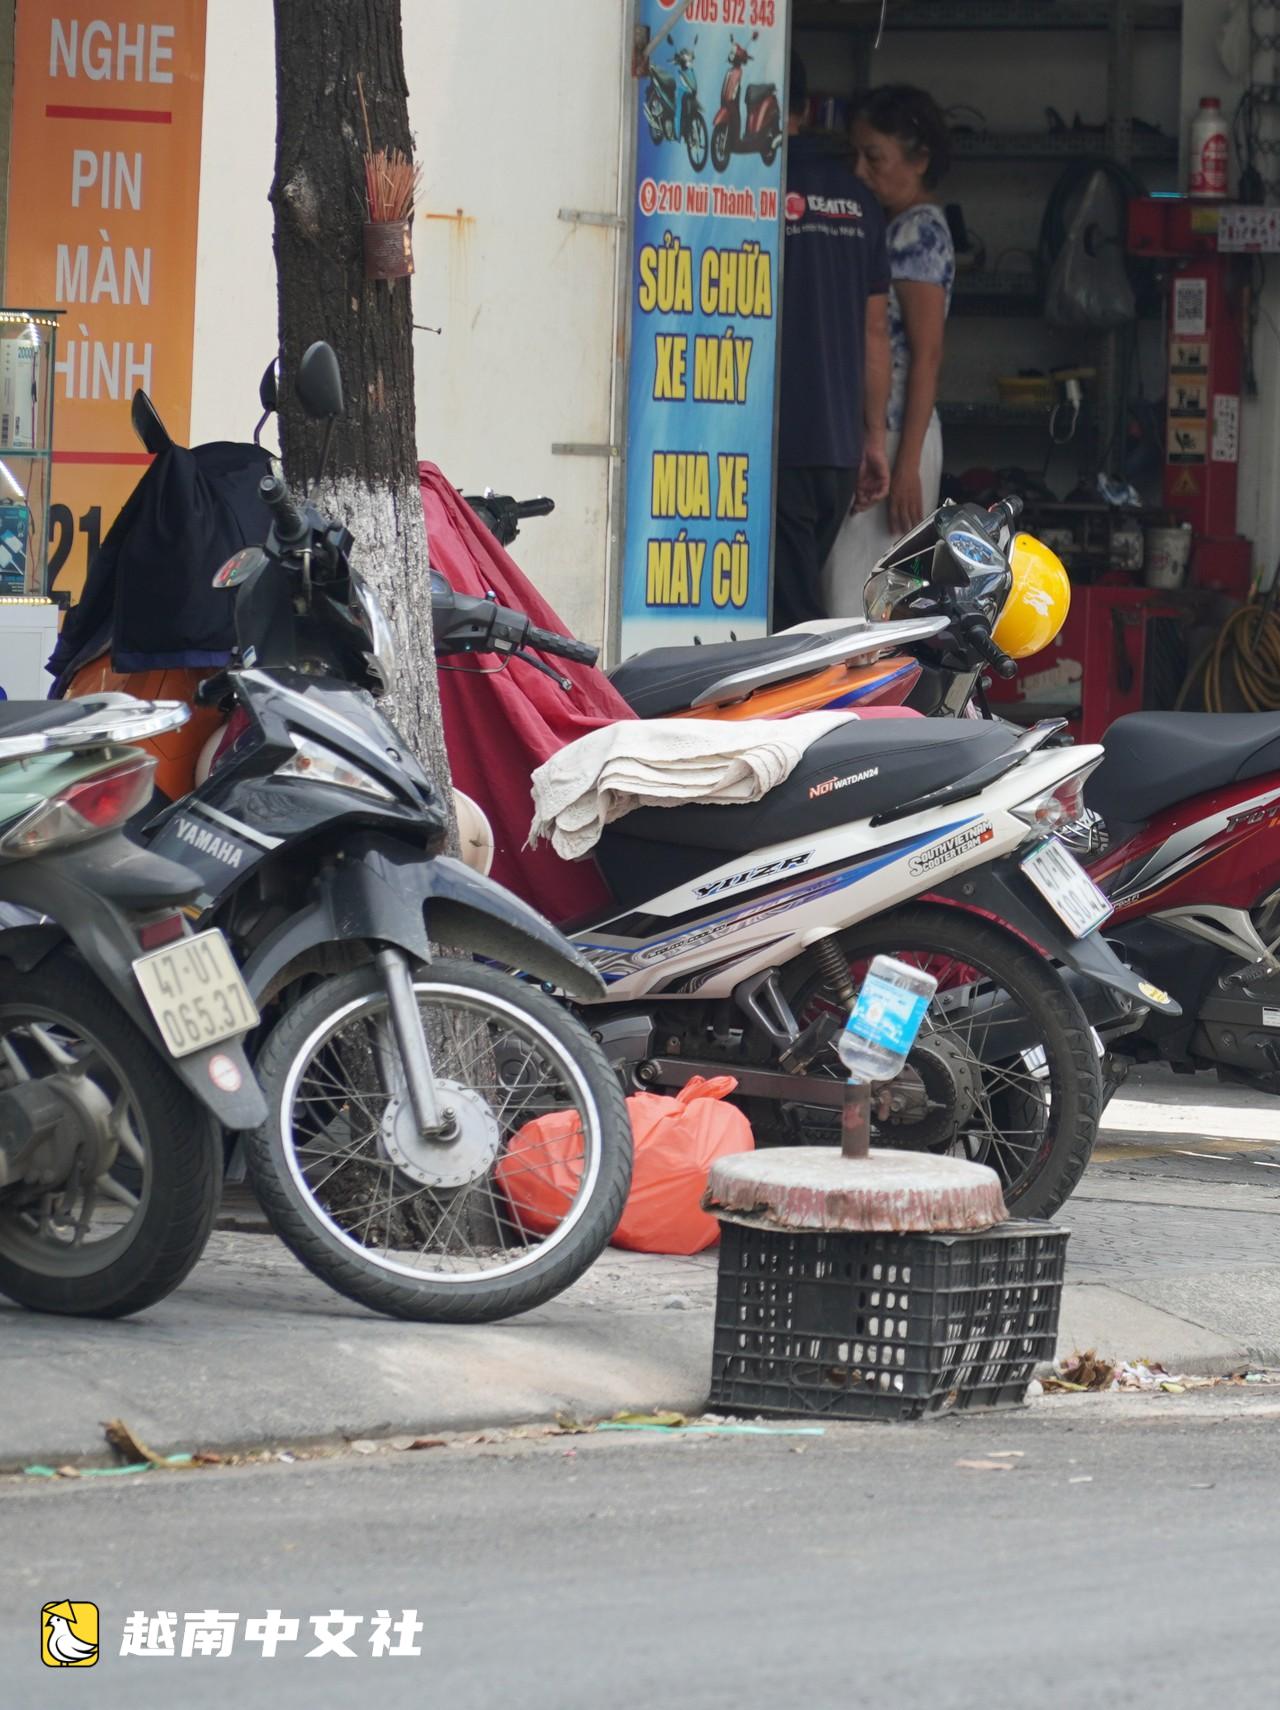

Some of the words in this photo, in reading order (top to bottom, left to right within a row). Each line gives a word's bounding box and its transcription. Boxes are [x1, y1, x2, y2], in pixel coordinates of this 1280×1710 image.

[723, 0, 746, 25] 972
[750, 0, 776, 28] 343
[48, 18, 175, 84] NGHE
[71, 151, 142, 210] PIN
[658, 183, 683, 213] 210
[759, 189, 778, 219] ĐN
[55, 229, 152, 305] MÀN
[638, 231, 693, 314] SỬA
[700, 237, 773, 318] CHỮA
[54, 325, 153, 401] HÌNH
[653, 334, 688, 401] XE
[693, 328, 753, 405] MÁY
[651, 452, 710, 519] MUA
[716, 452, 750, 520] XE
[646, 531, 706, 607] MÁY
[711, 531, 750, 609] CŨ
[175, 817, 244, 869] YAMAHA
[150, 940, 224, 1000] 47-U1
[161, 982, 250, 1049] 065.37
